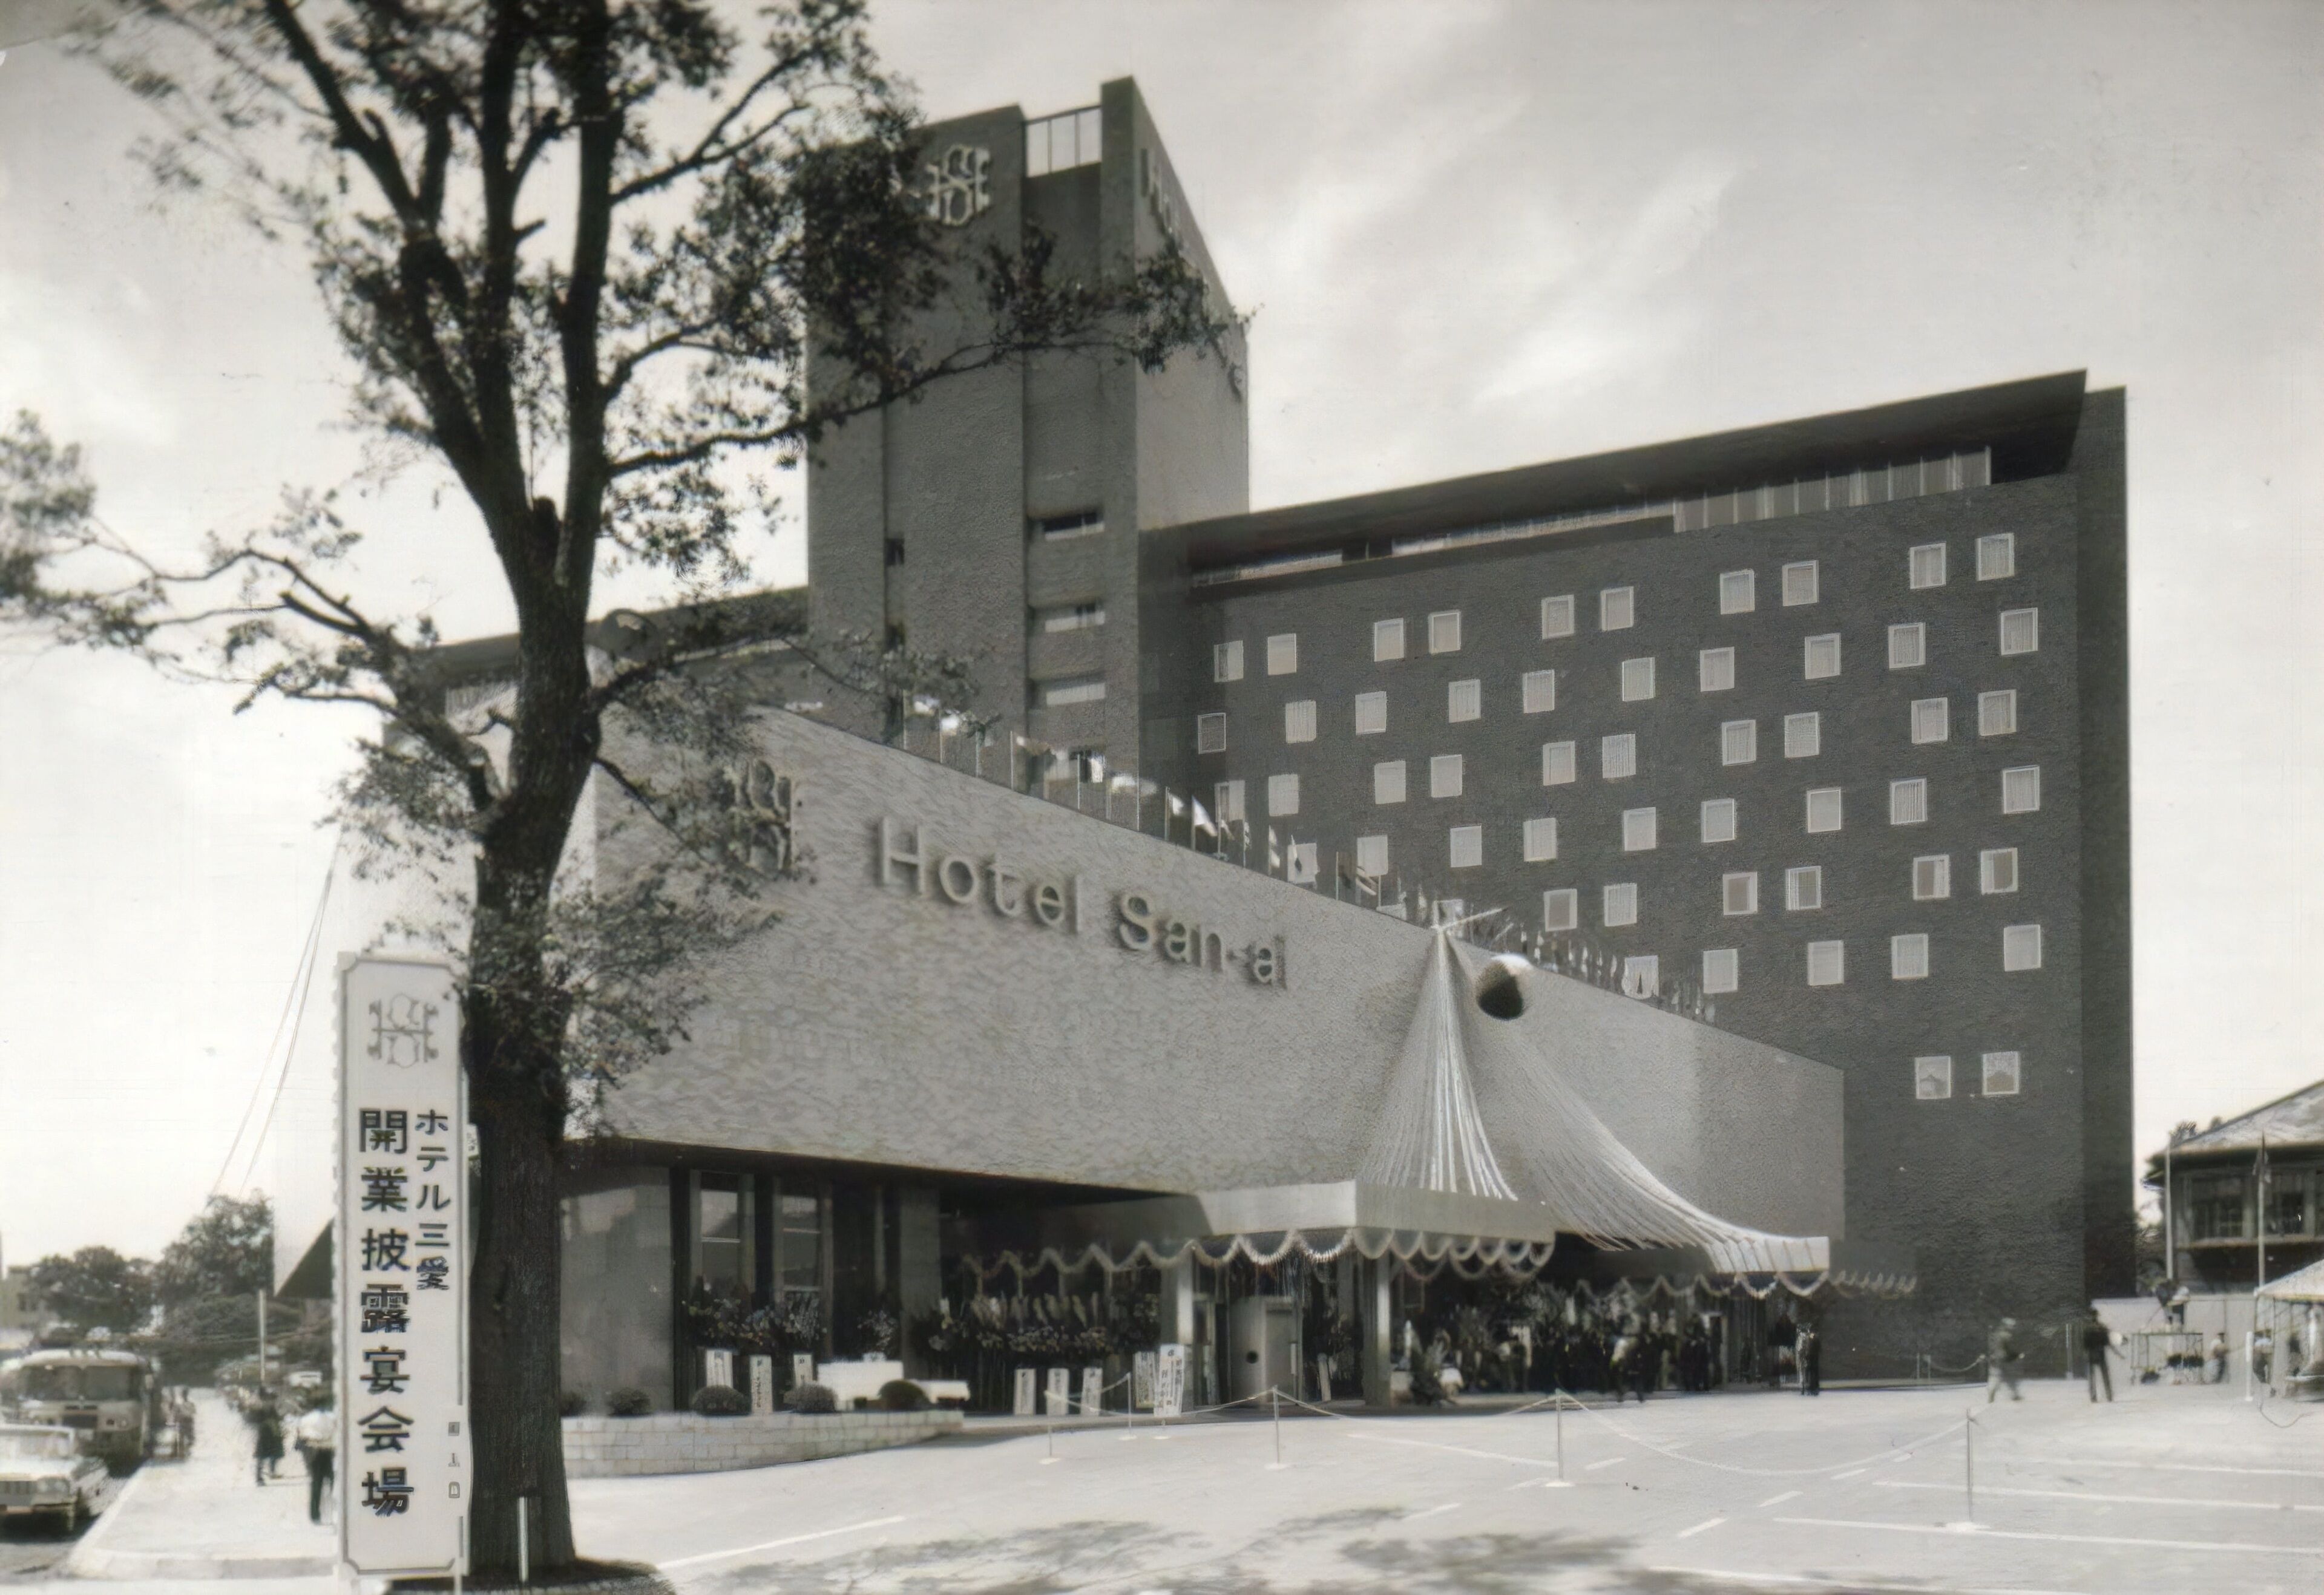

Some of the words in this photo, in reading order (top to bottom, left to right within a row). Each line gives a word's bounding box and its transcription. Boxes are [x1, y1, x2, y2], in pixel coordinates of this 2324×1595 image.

[876, 817, 1088, 934] Hotel
[414, 1108, 451, 1291] ホテル三愛
[358, 1108, 415, 1518] 開業披露宴会場
